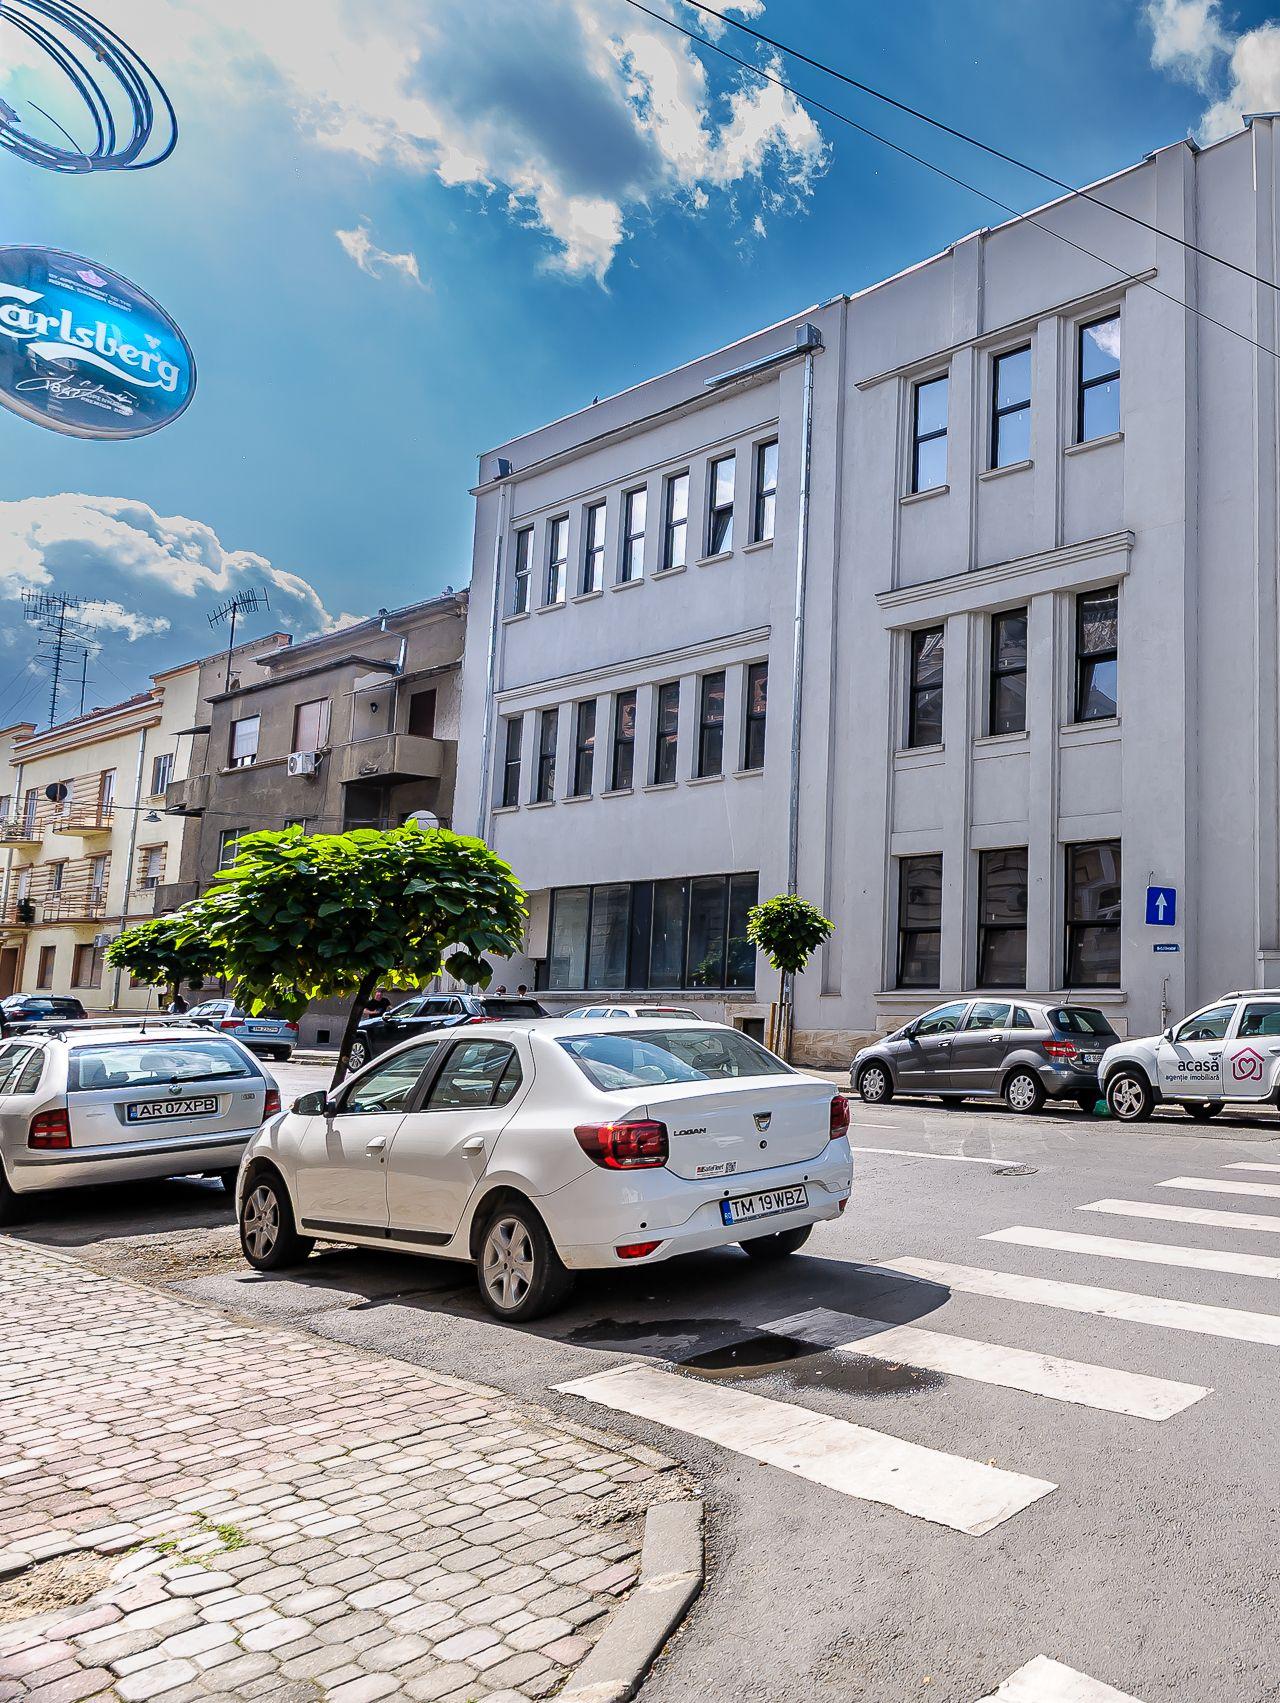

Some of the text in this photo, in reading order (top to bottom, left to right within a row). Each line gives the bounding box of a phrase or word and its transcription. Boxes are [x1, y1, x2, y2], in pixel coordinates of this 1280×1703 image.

[1177, 1057, 1220, 1072] acasă
[139, 1099, 215, 1117] AR 07XPB
[673, 1127, 707, 1137] LOGAN
[731, 1198, 755, 1217] TM
